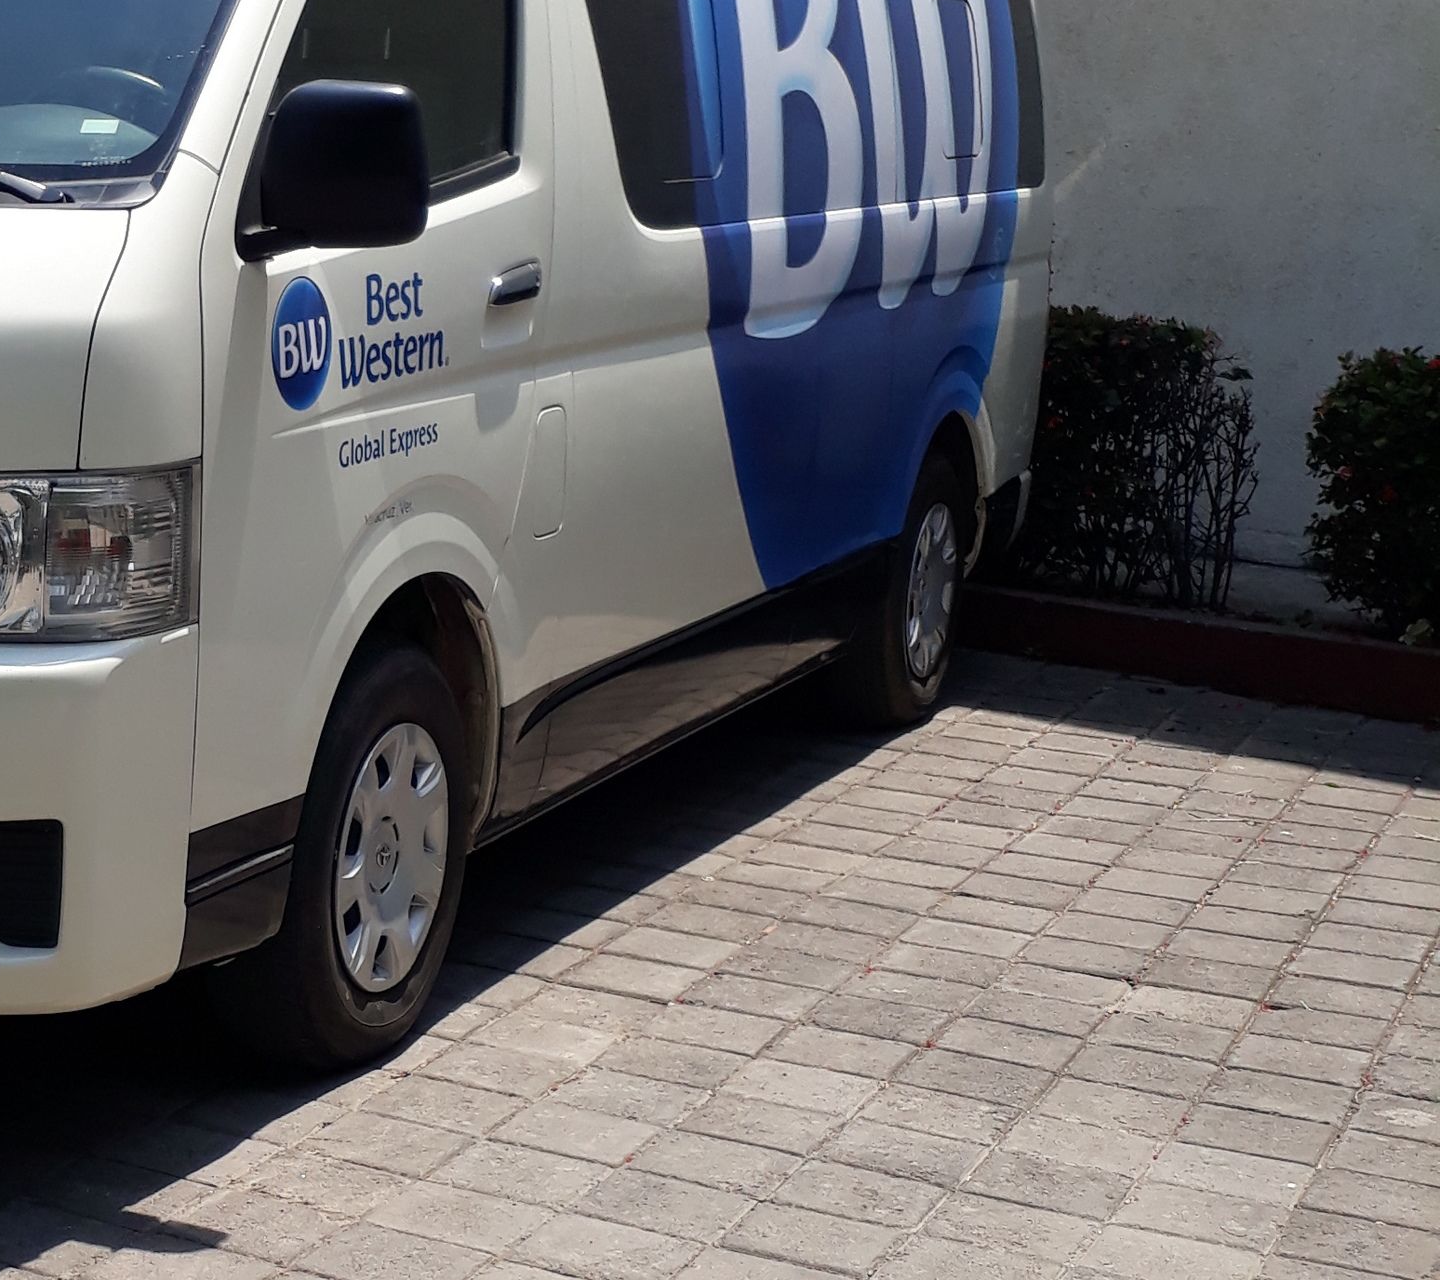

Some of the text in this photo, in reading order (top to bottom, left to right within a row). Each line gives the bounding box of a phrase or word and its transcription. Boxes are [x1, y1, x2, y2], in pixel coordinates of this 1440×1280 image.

[365, 272, 424, 326] Best
[278, 315, 327, 380] BW
[338, 422, 439, 468] Global Express
